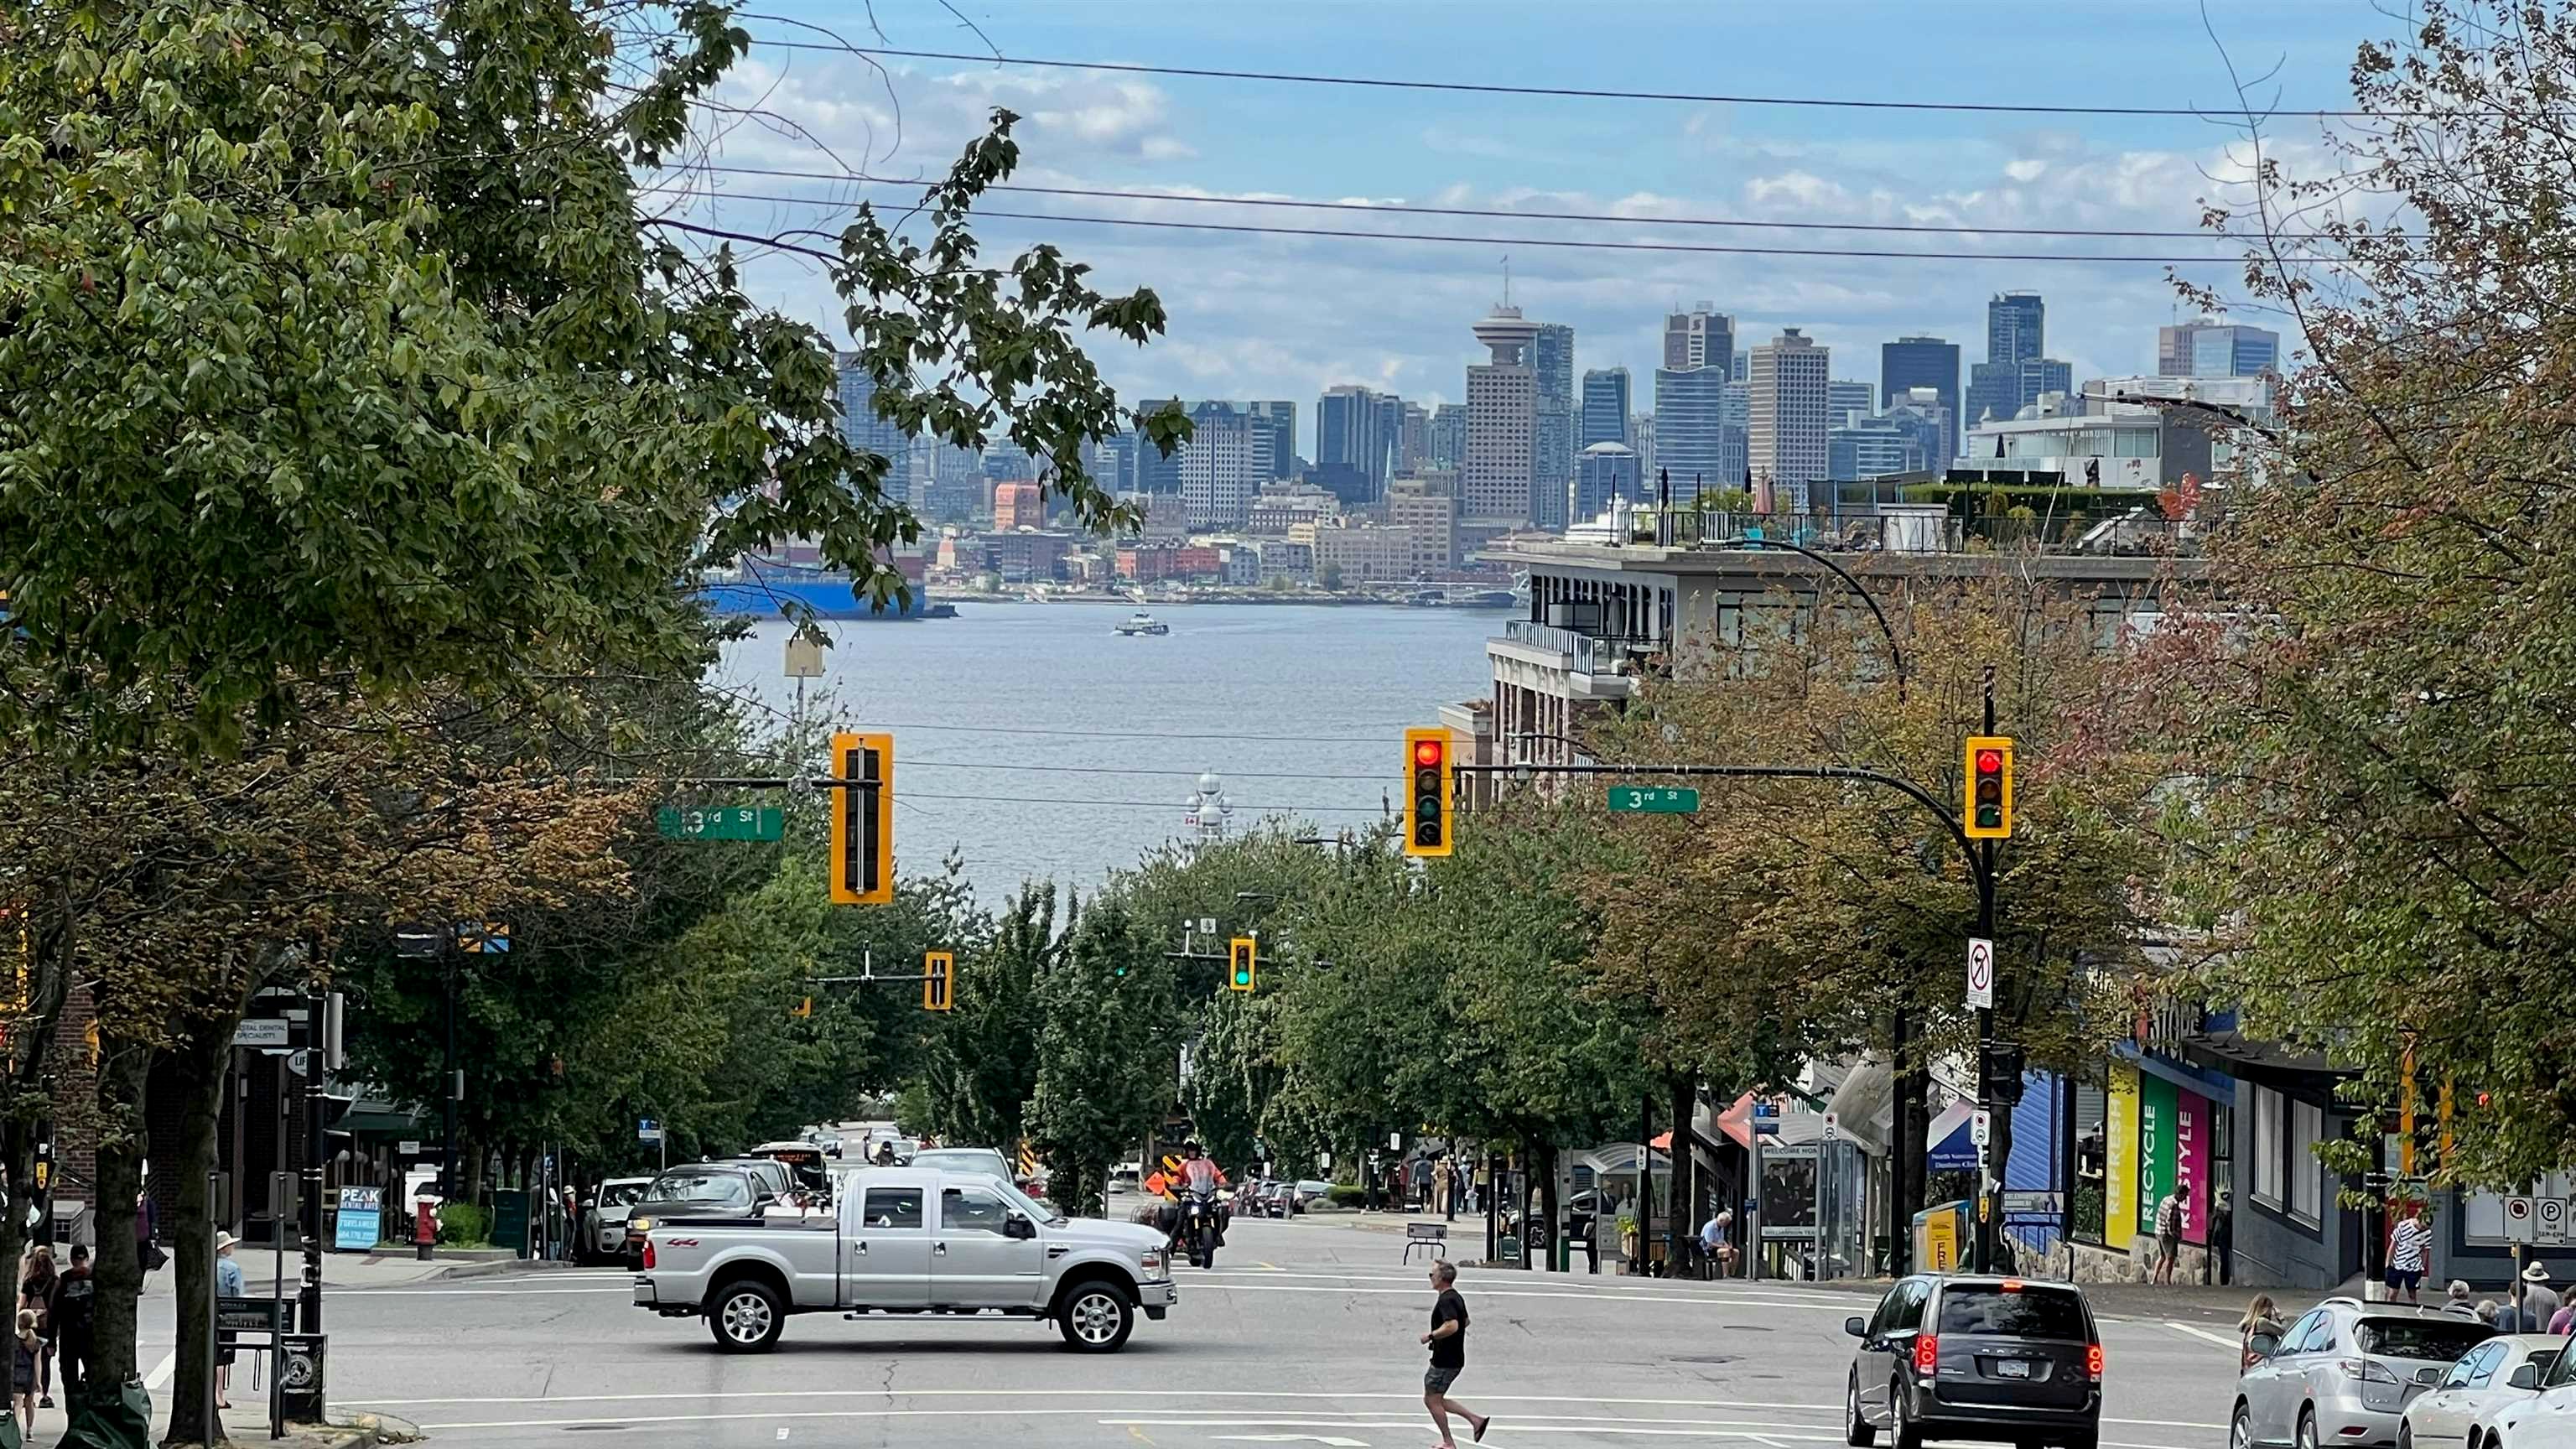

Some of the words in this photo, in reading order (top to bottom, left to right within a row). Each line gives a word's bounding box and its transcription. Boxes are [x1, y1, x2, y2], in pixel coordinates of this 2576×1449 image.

[1628, 791, 1654, 809] 3rd
[1667, 791, 1678, 800] St
[688, 811, 722, 834] 3rd
[739, 810, 754, 823] St
[1763, 1146, 1800, 1155] WELCOME
[2108, 1098, 2122, 1215] REFRESH
[2143, 1104, 2156, 1223] RECYCLE
[2178, 1111, 2191, 1229] RESTYLE
[340, 1188, 380, 1202] PEAK
[340, 1201, 363, 1210] DENTAL
[363, 1202, 379, 1210] ARTS
[2547, 1206, 2556, 1217] P
[1938, 1242, 1947, 1269] FRE
